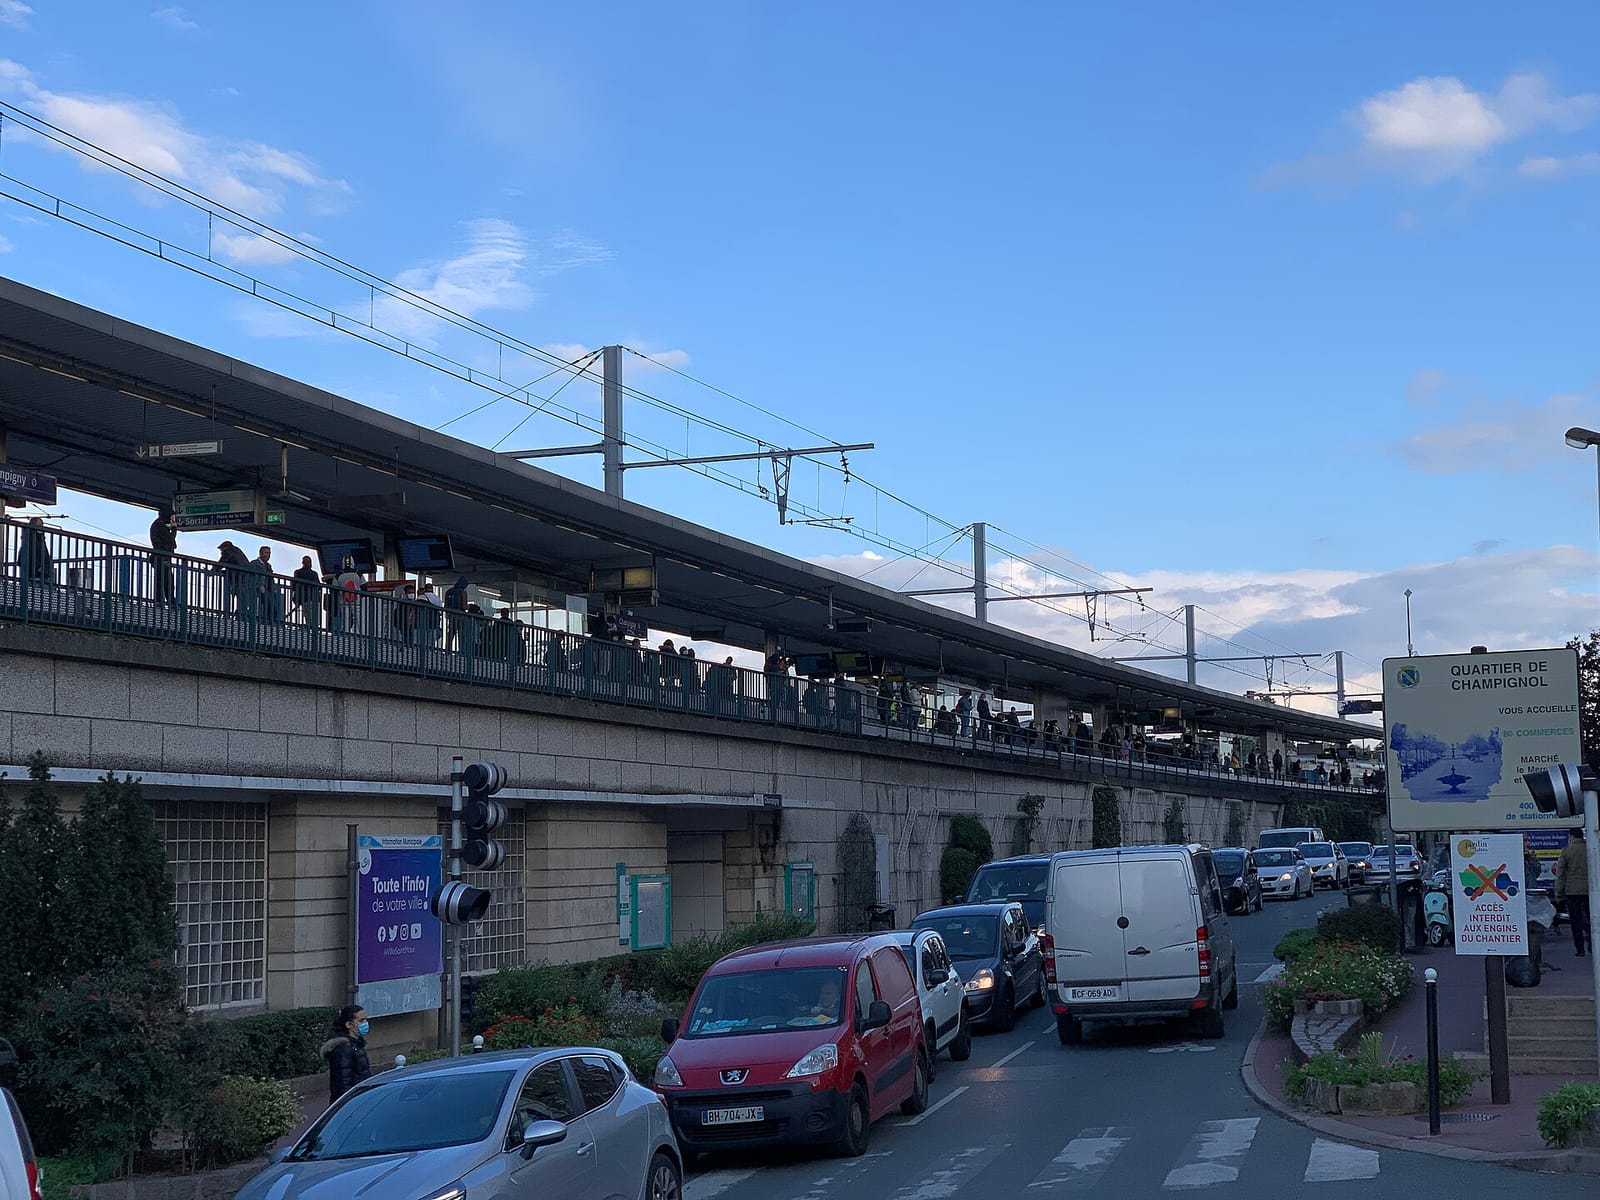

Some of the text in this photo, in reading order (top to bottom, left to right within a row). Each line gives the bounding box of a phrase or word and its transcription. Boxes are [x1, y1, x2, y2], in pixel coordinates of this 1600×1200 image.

[185, 516, 209, 525] Sortie
[1450, 661, 1548, 677] QUARTIER DE
[1451, 676, 1548, 691] CHAMPIGNOL
[1498, 704, 1577, 715] VOUS ACCUEILLE
[1516, 727, 1575, 737] COMMERCES
[1520, 754, 1560, 763] MARCHÉ
[1513, 776, 1522, 784] et
[1519, 802, 1534, 810] 400
[1505, 812, 1516, 820] de
[372, 876, 400, 894] Toute
[372, 895, 423, 913] de votre ville
[1475, 901, 1504, 912] ACCÈS
[1469, 914, 1511, 922] INTERDIT
[1464, 924, 1518, 932] AUX ENGINS
[1461, 934, 1521, 943] DU CHANTIER
[708, 1107, 757, 1123] BH-704-JX
